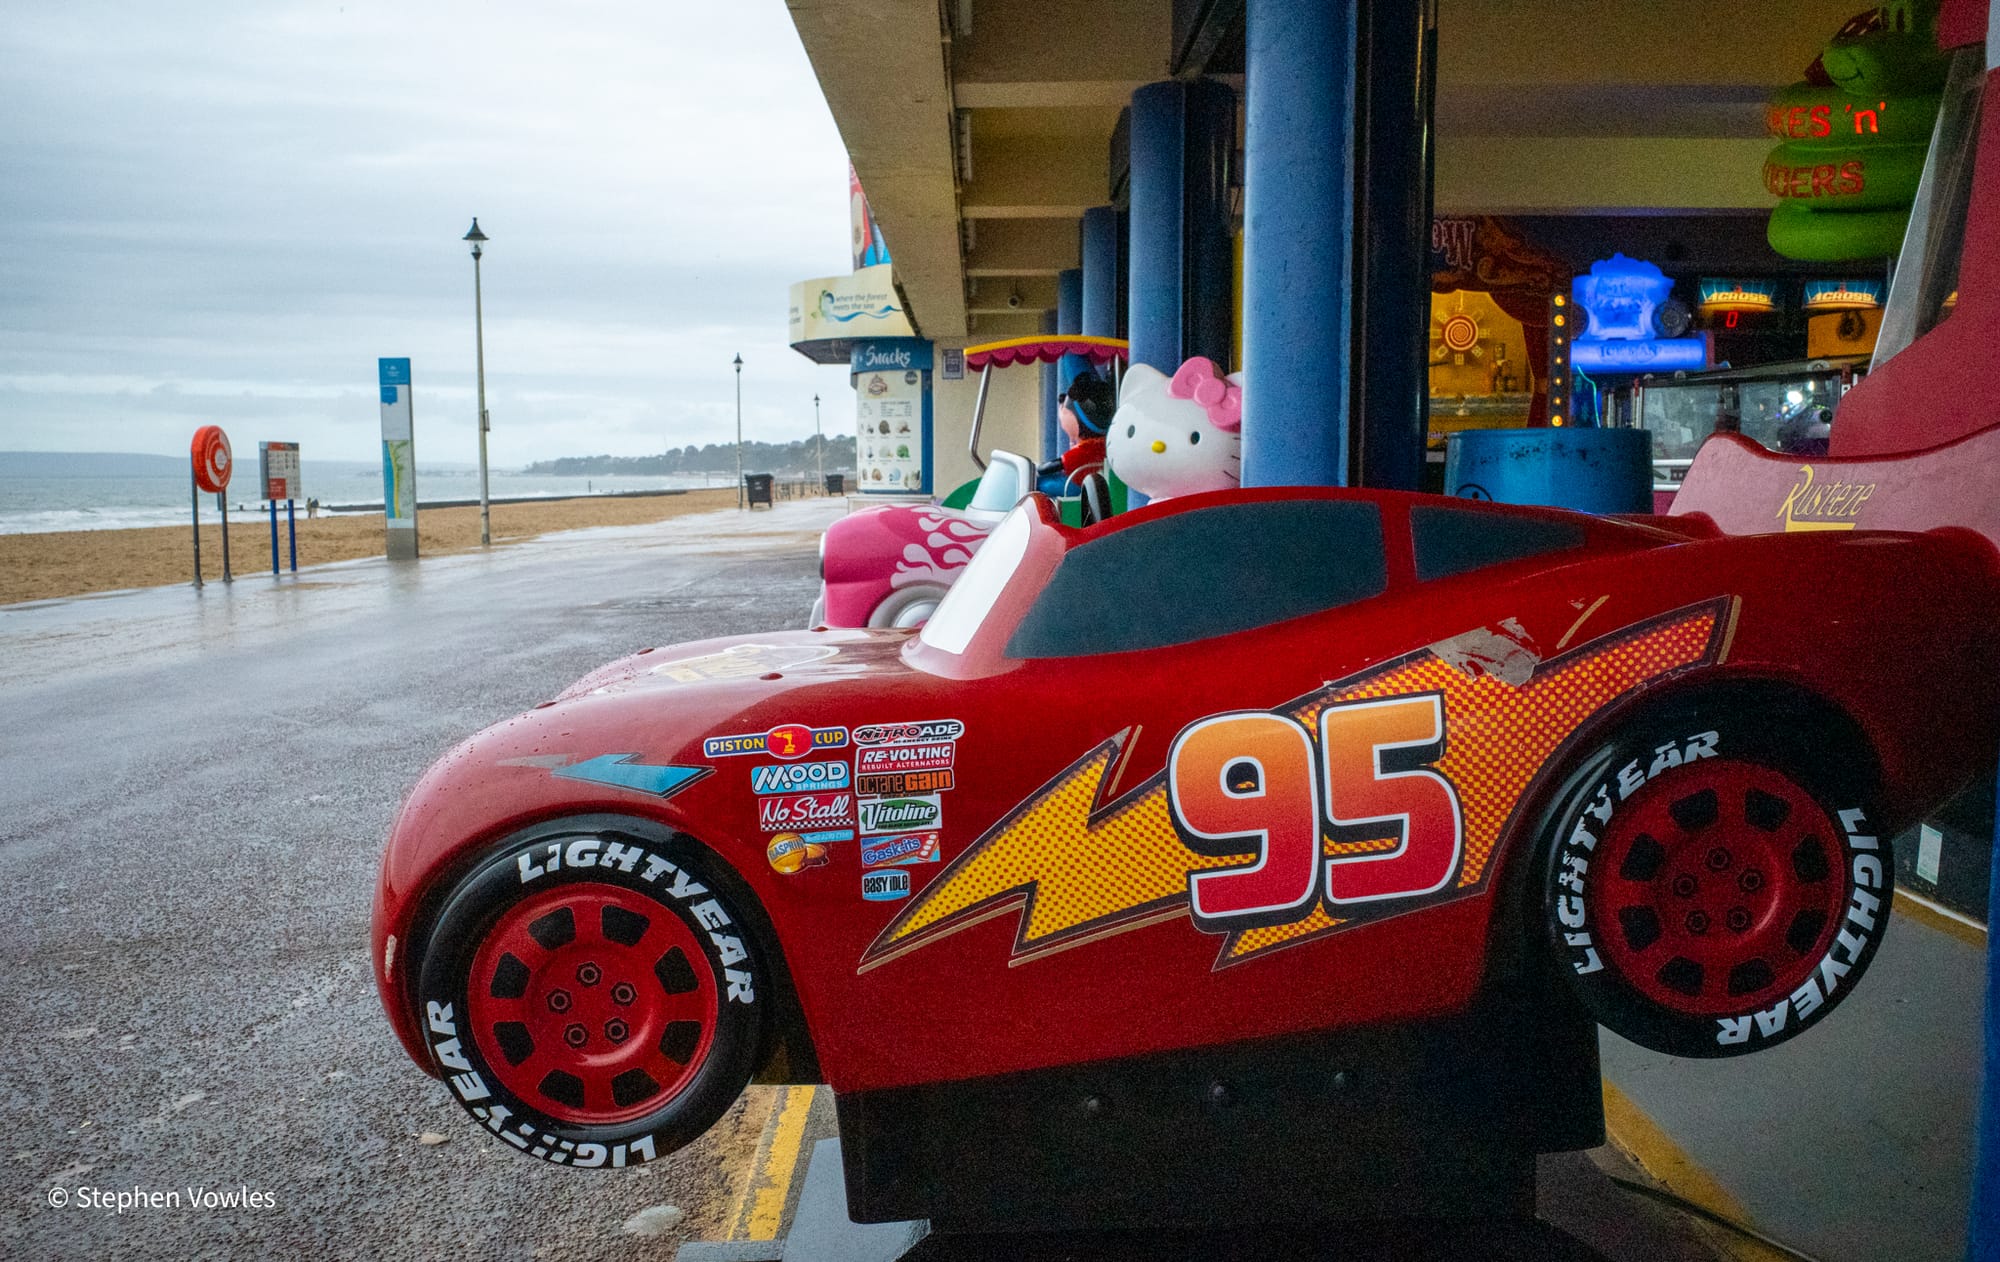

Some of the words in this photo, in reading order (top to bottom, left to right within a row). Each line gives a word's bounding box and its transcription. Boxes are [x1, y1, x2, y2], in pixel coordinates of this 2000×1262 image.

[866, 345, 911, 367] Snacks
[709, 737, 764, 753] PISTON
[815, 731, 844, 744] CUP
[863, 746, 951, 763] RE-VOLTING
[754, 762, 847, 792] MOOD
[862, 763, 893, 771] REBUILT
[896, 759, 950, 769] ALTERNATORS
[796, 781, 843, 791] SPRINGS
[762, 798, 791, 823] No
[792, 795, 850, 820] Stall
[860, 802, 938, 831] Vitoline
[1169, 695, 1463, 918] 95
[863, 838, 921, 865] Gask-its
[1558, 731, 1719, 975] LIGHTYEAR
[517, 840, 754, 1004] LIGHTYEAR
[1717, 808, 1883, 1045] LIGHTYEAR
